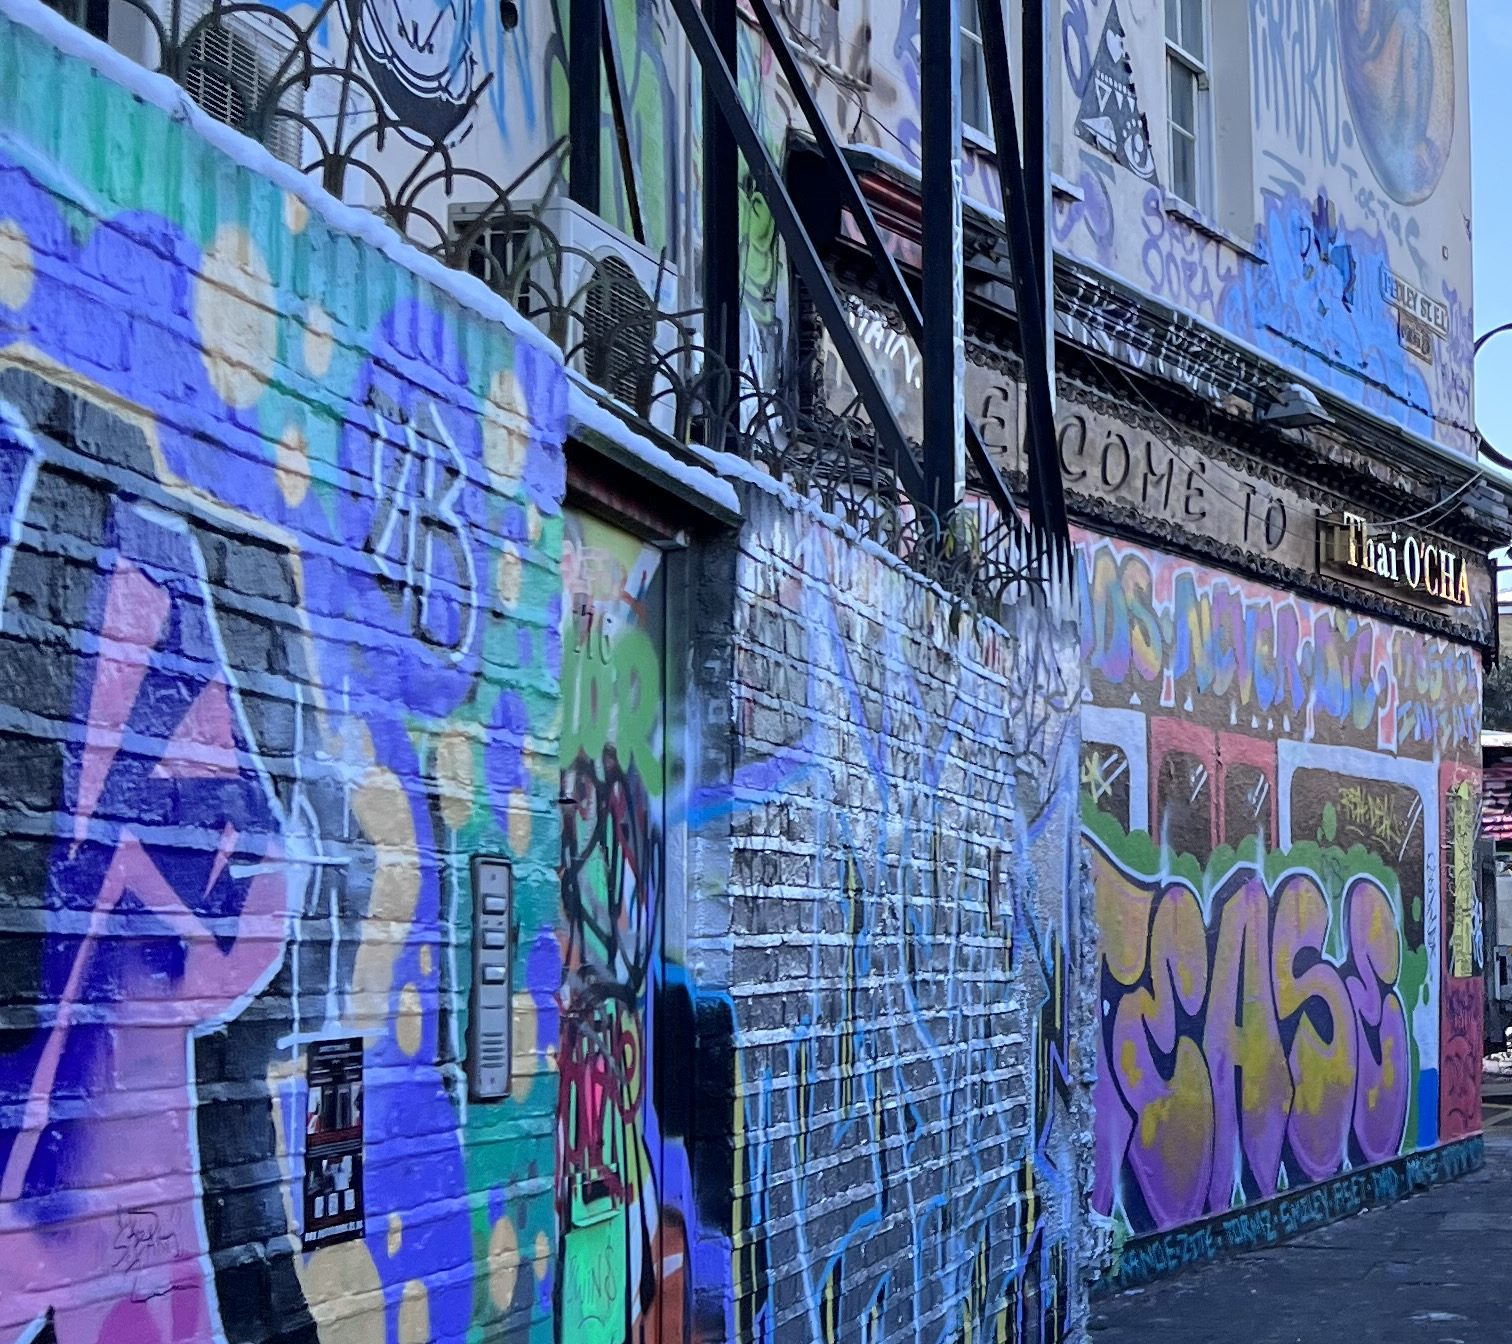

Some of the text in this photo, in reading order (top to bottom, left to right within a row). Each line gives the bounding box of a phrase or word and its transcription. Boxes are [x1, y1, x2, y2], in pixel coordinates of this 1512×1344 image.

[1239, 481, 1287, 552] TO
[1343, 511, 1472, 606] Thai O'CHA
